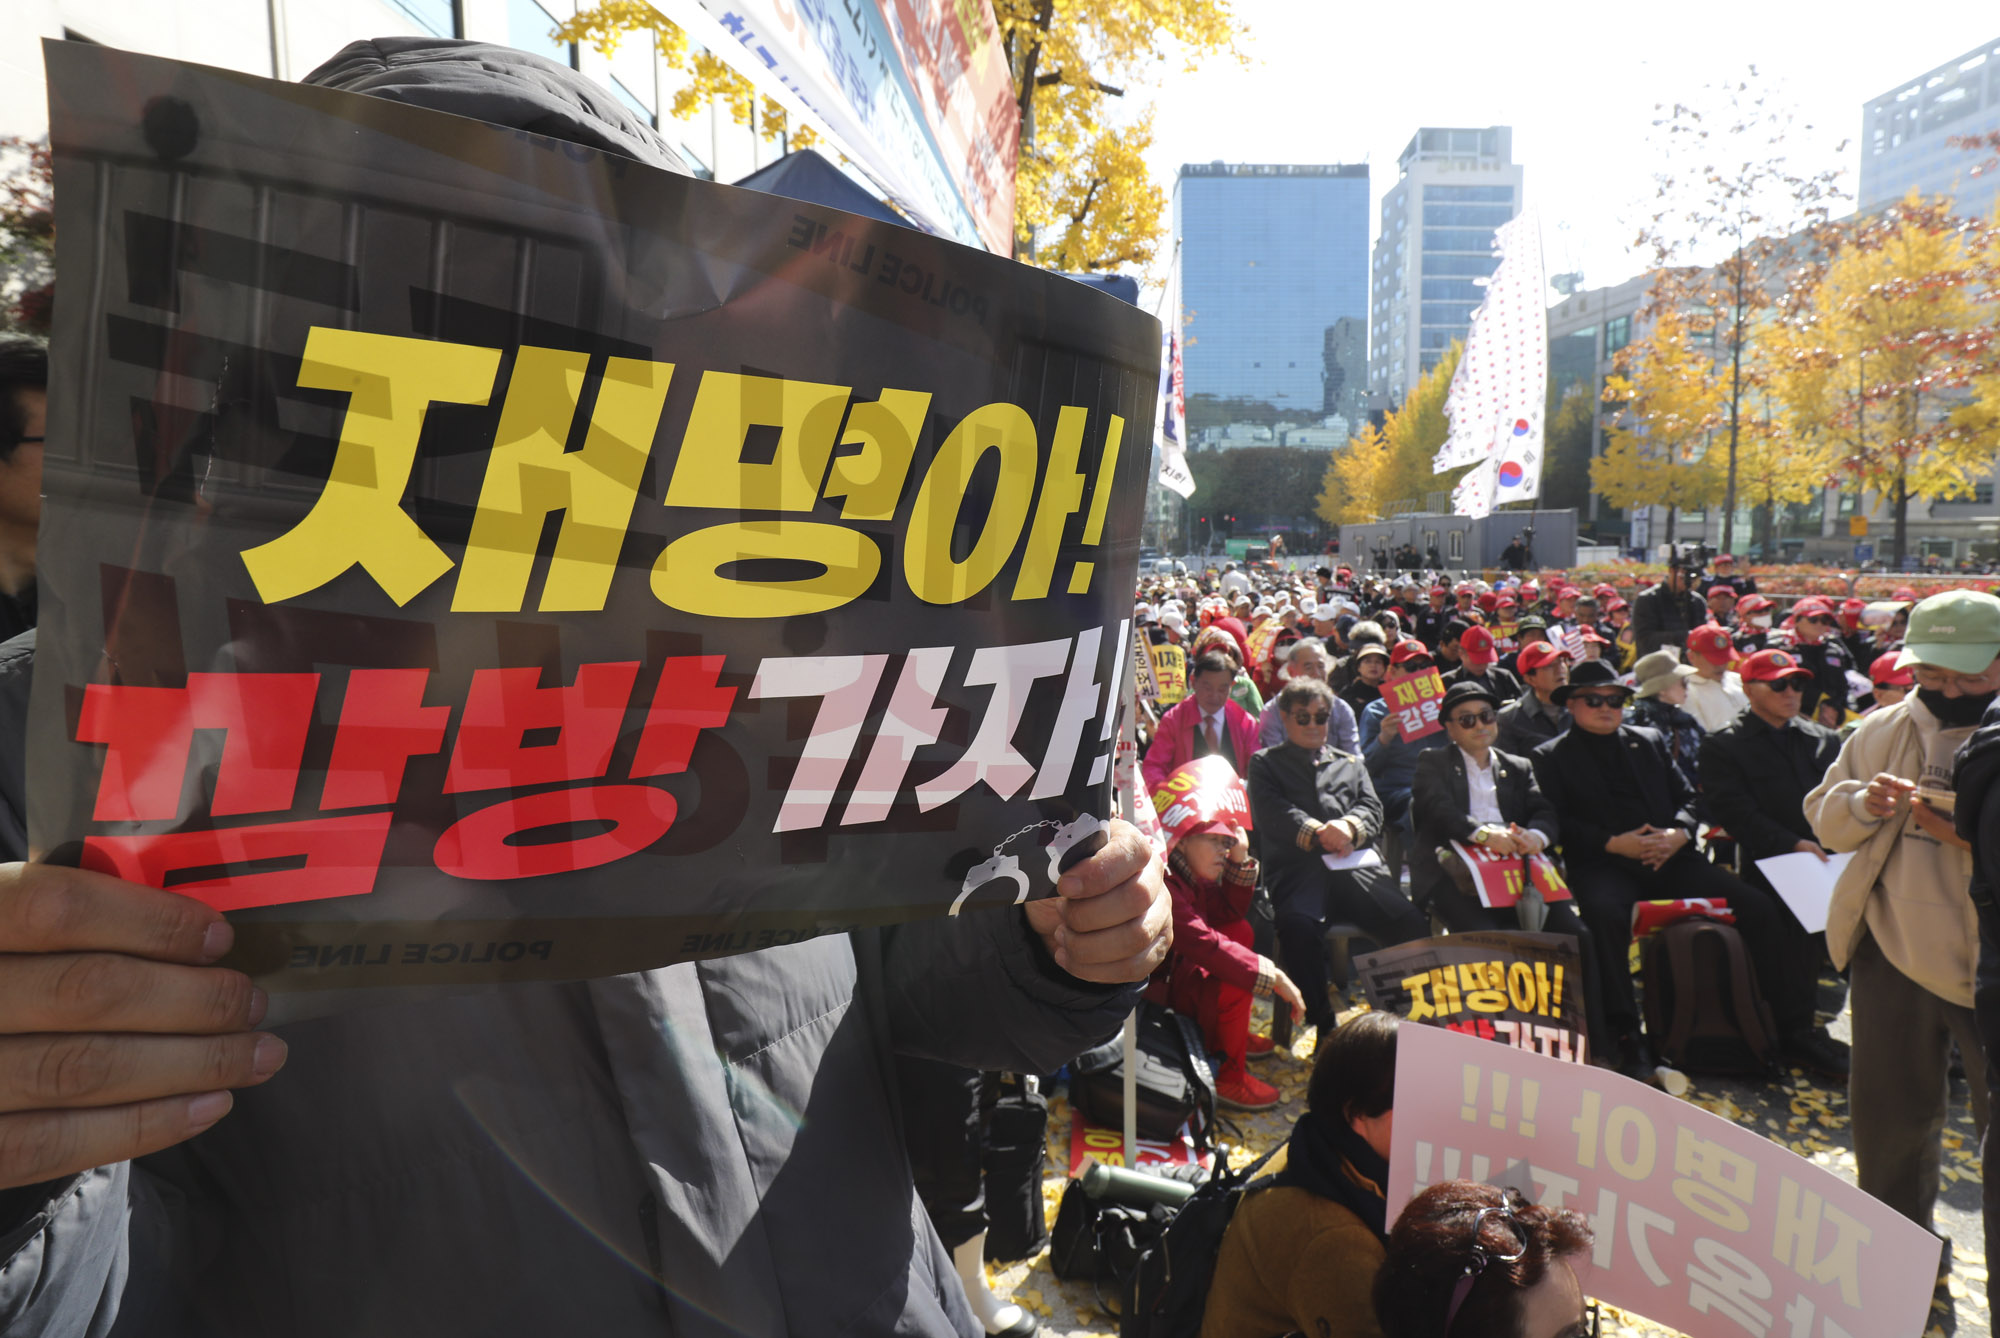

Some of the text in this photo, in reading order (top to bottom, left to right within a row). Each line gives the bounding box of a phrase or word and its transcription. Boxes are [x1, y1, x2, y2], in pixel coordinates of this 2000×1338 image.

[240, 326, 1125, 618] 재명아!
[748, 618, 1130, 832] 가자!
[1399, 697, 1443, 733] 감옥
[1402, 960, 1564, 1021] 재명아!
